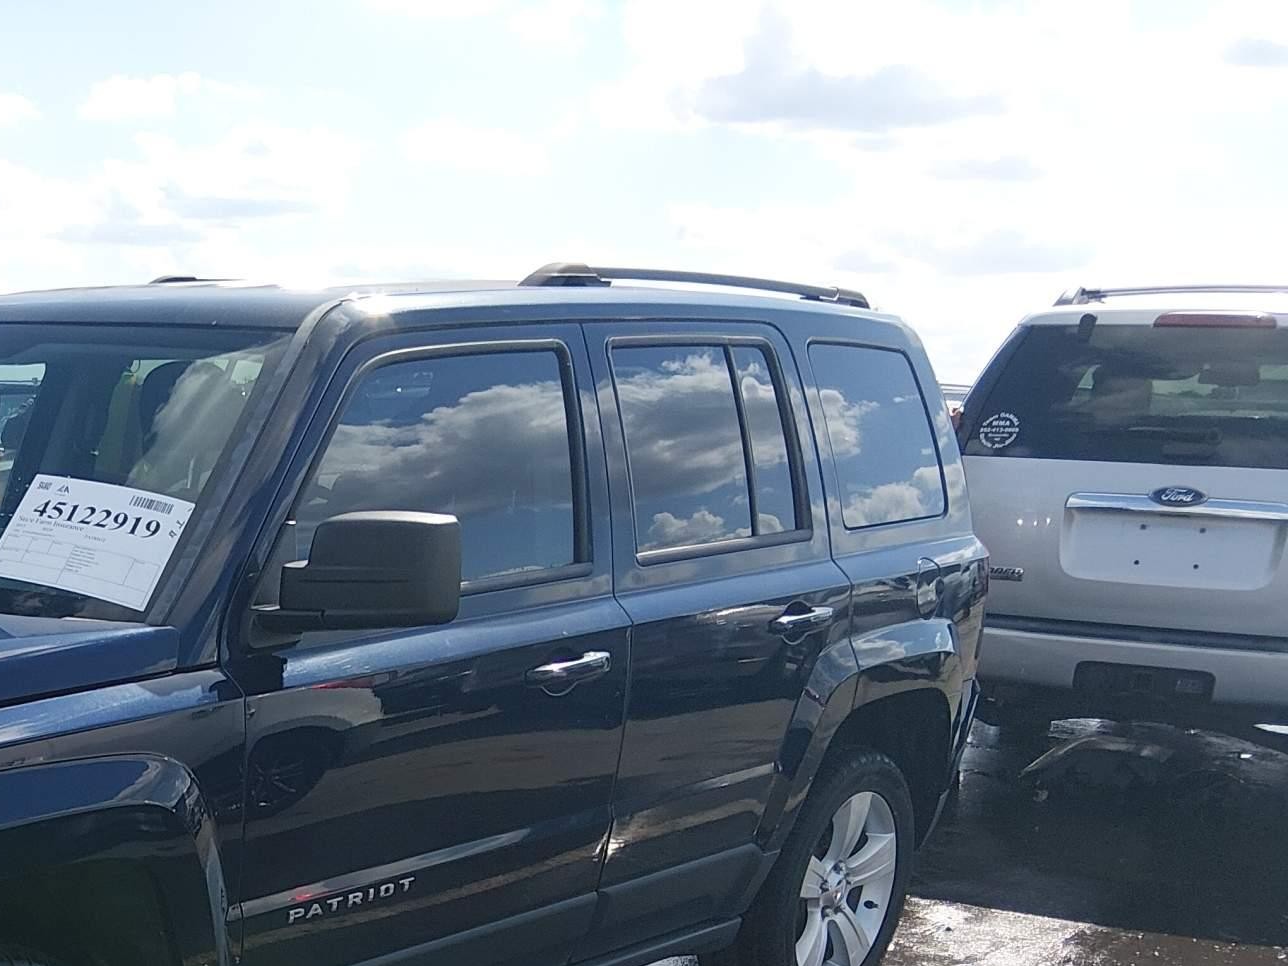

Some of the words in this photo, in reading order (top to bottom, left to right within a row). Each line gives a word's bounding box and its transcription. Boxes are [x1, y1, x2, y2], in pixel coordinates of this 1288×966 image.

[1160, 488, 1195, 503] Ford
[33, 499, 162, 539] 45122919
[288, 877, 416, 924] PATRIOT
